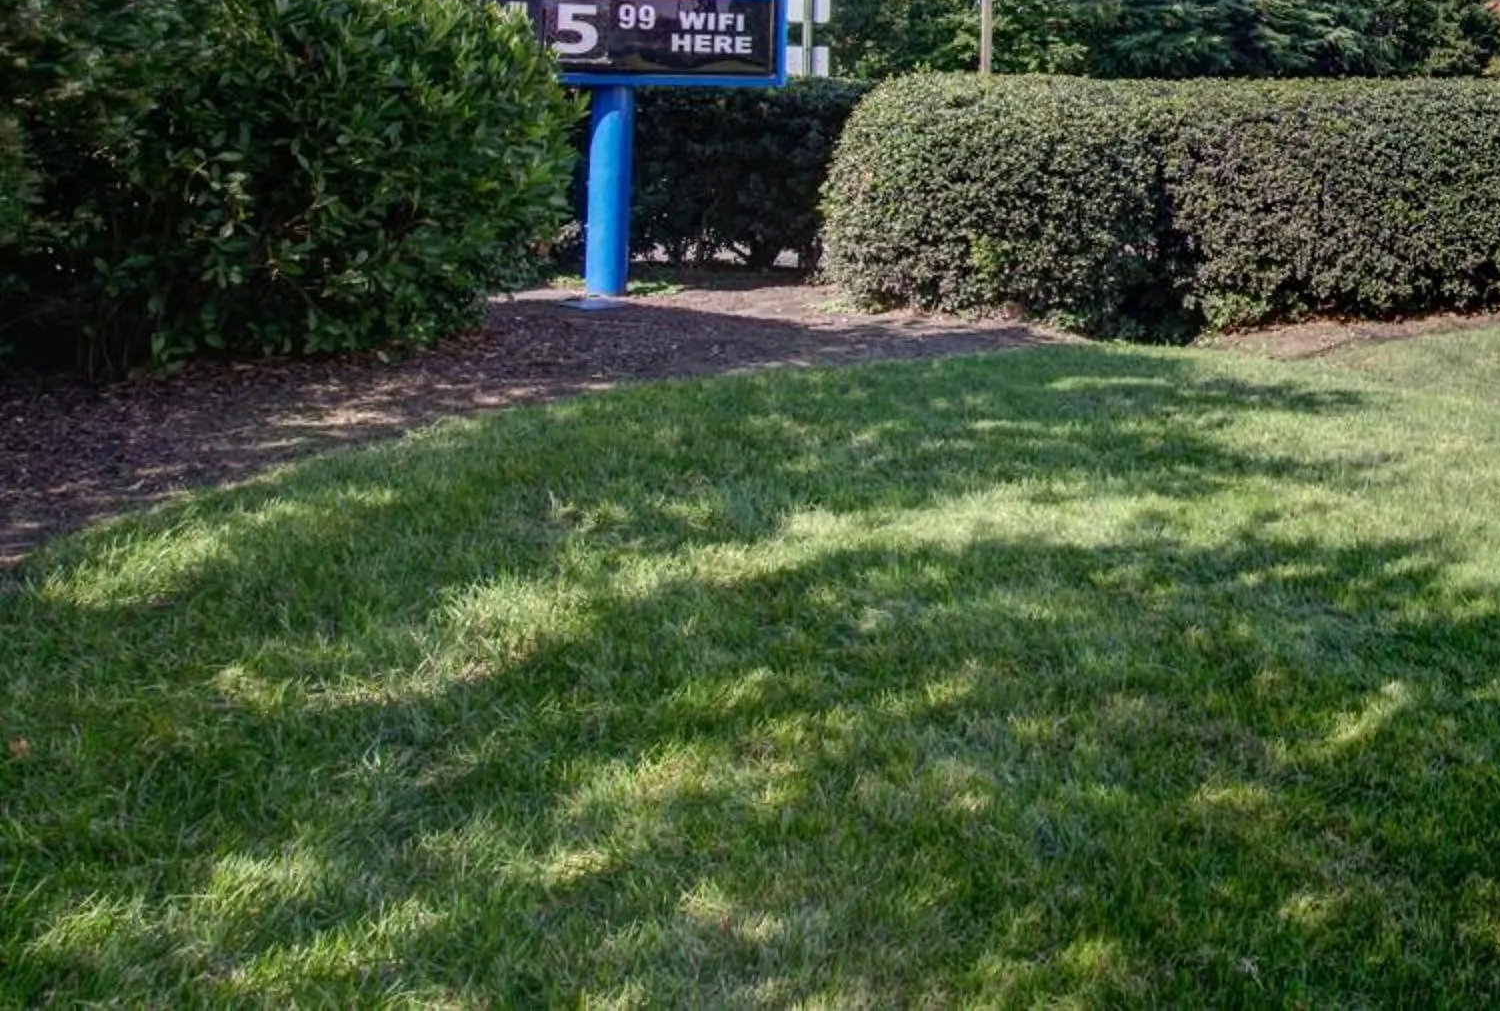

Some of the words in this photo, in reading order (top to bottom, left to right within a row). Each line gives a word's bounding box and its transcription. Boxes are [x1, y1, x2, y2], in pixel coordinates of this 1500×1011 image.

[619, 4, 656, 30] 99
[679, 11, 745, 32] WIFI
[671, 33, 752, 54] HERE
